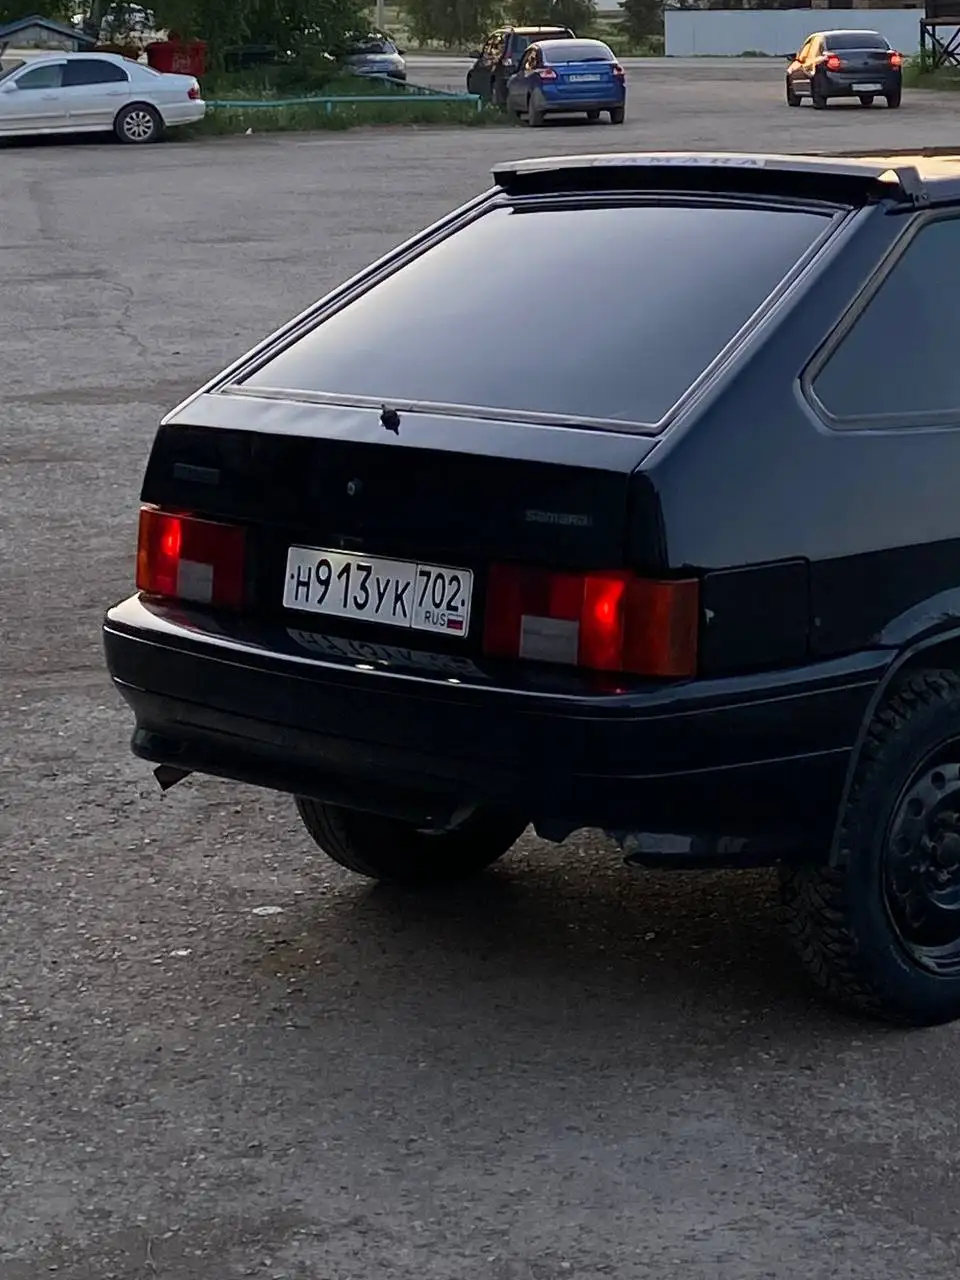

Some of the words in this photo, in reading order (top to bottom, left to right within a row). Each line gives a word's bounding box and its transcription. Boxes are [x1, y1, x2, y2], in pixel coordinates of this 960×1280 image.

[294, 558, 411, 618] Н913УК
[418, 570, 462, 612] 702
[424, 610, 447, 627] RUS
